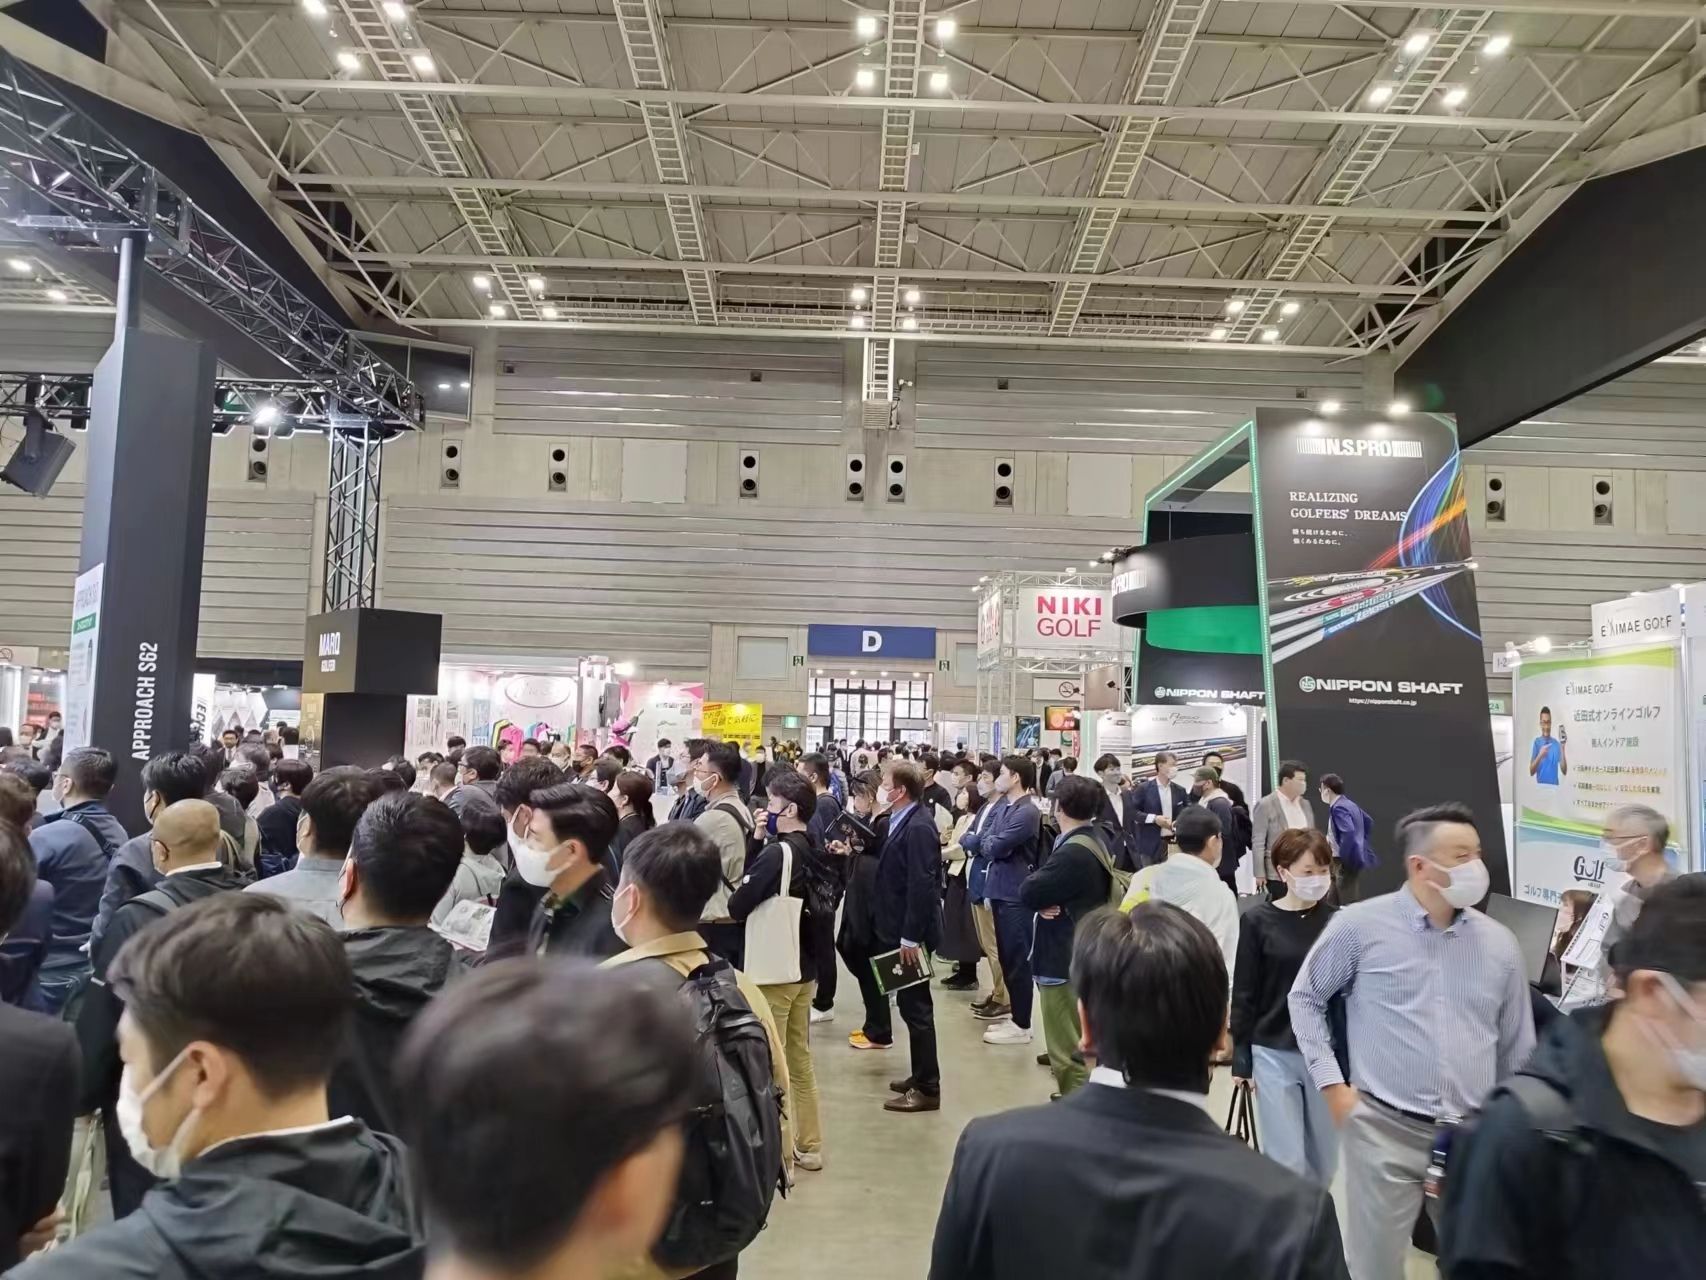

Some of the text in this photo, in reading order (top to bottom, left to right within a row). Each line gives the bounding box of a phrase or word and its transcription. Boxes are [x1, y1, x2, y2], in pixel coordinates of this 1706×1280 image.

[1289, 491, 1359, 504] REALIZING
[1354, 510, 1408, 522] DREAMS
[1037, 595, 1102, 616] NIKI
[1037, 617, 1101, 638] GOLF
[1643, 615, 1673, 632] GOLF
[862, 630, 883, 652] D
[1165, 688, 1266, 700] NIPPON SHAFT
[1316, 678, 1463, 695] NIPPON SHAFT
[1594, 682, 1613, 694] GOLF
[131, 641, 159, 761] APPROACH S62
